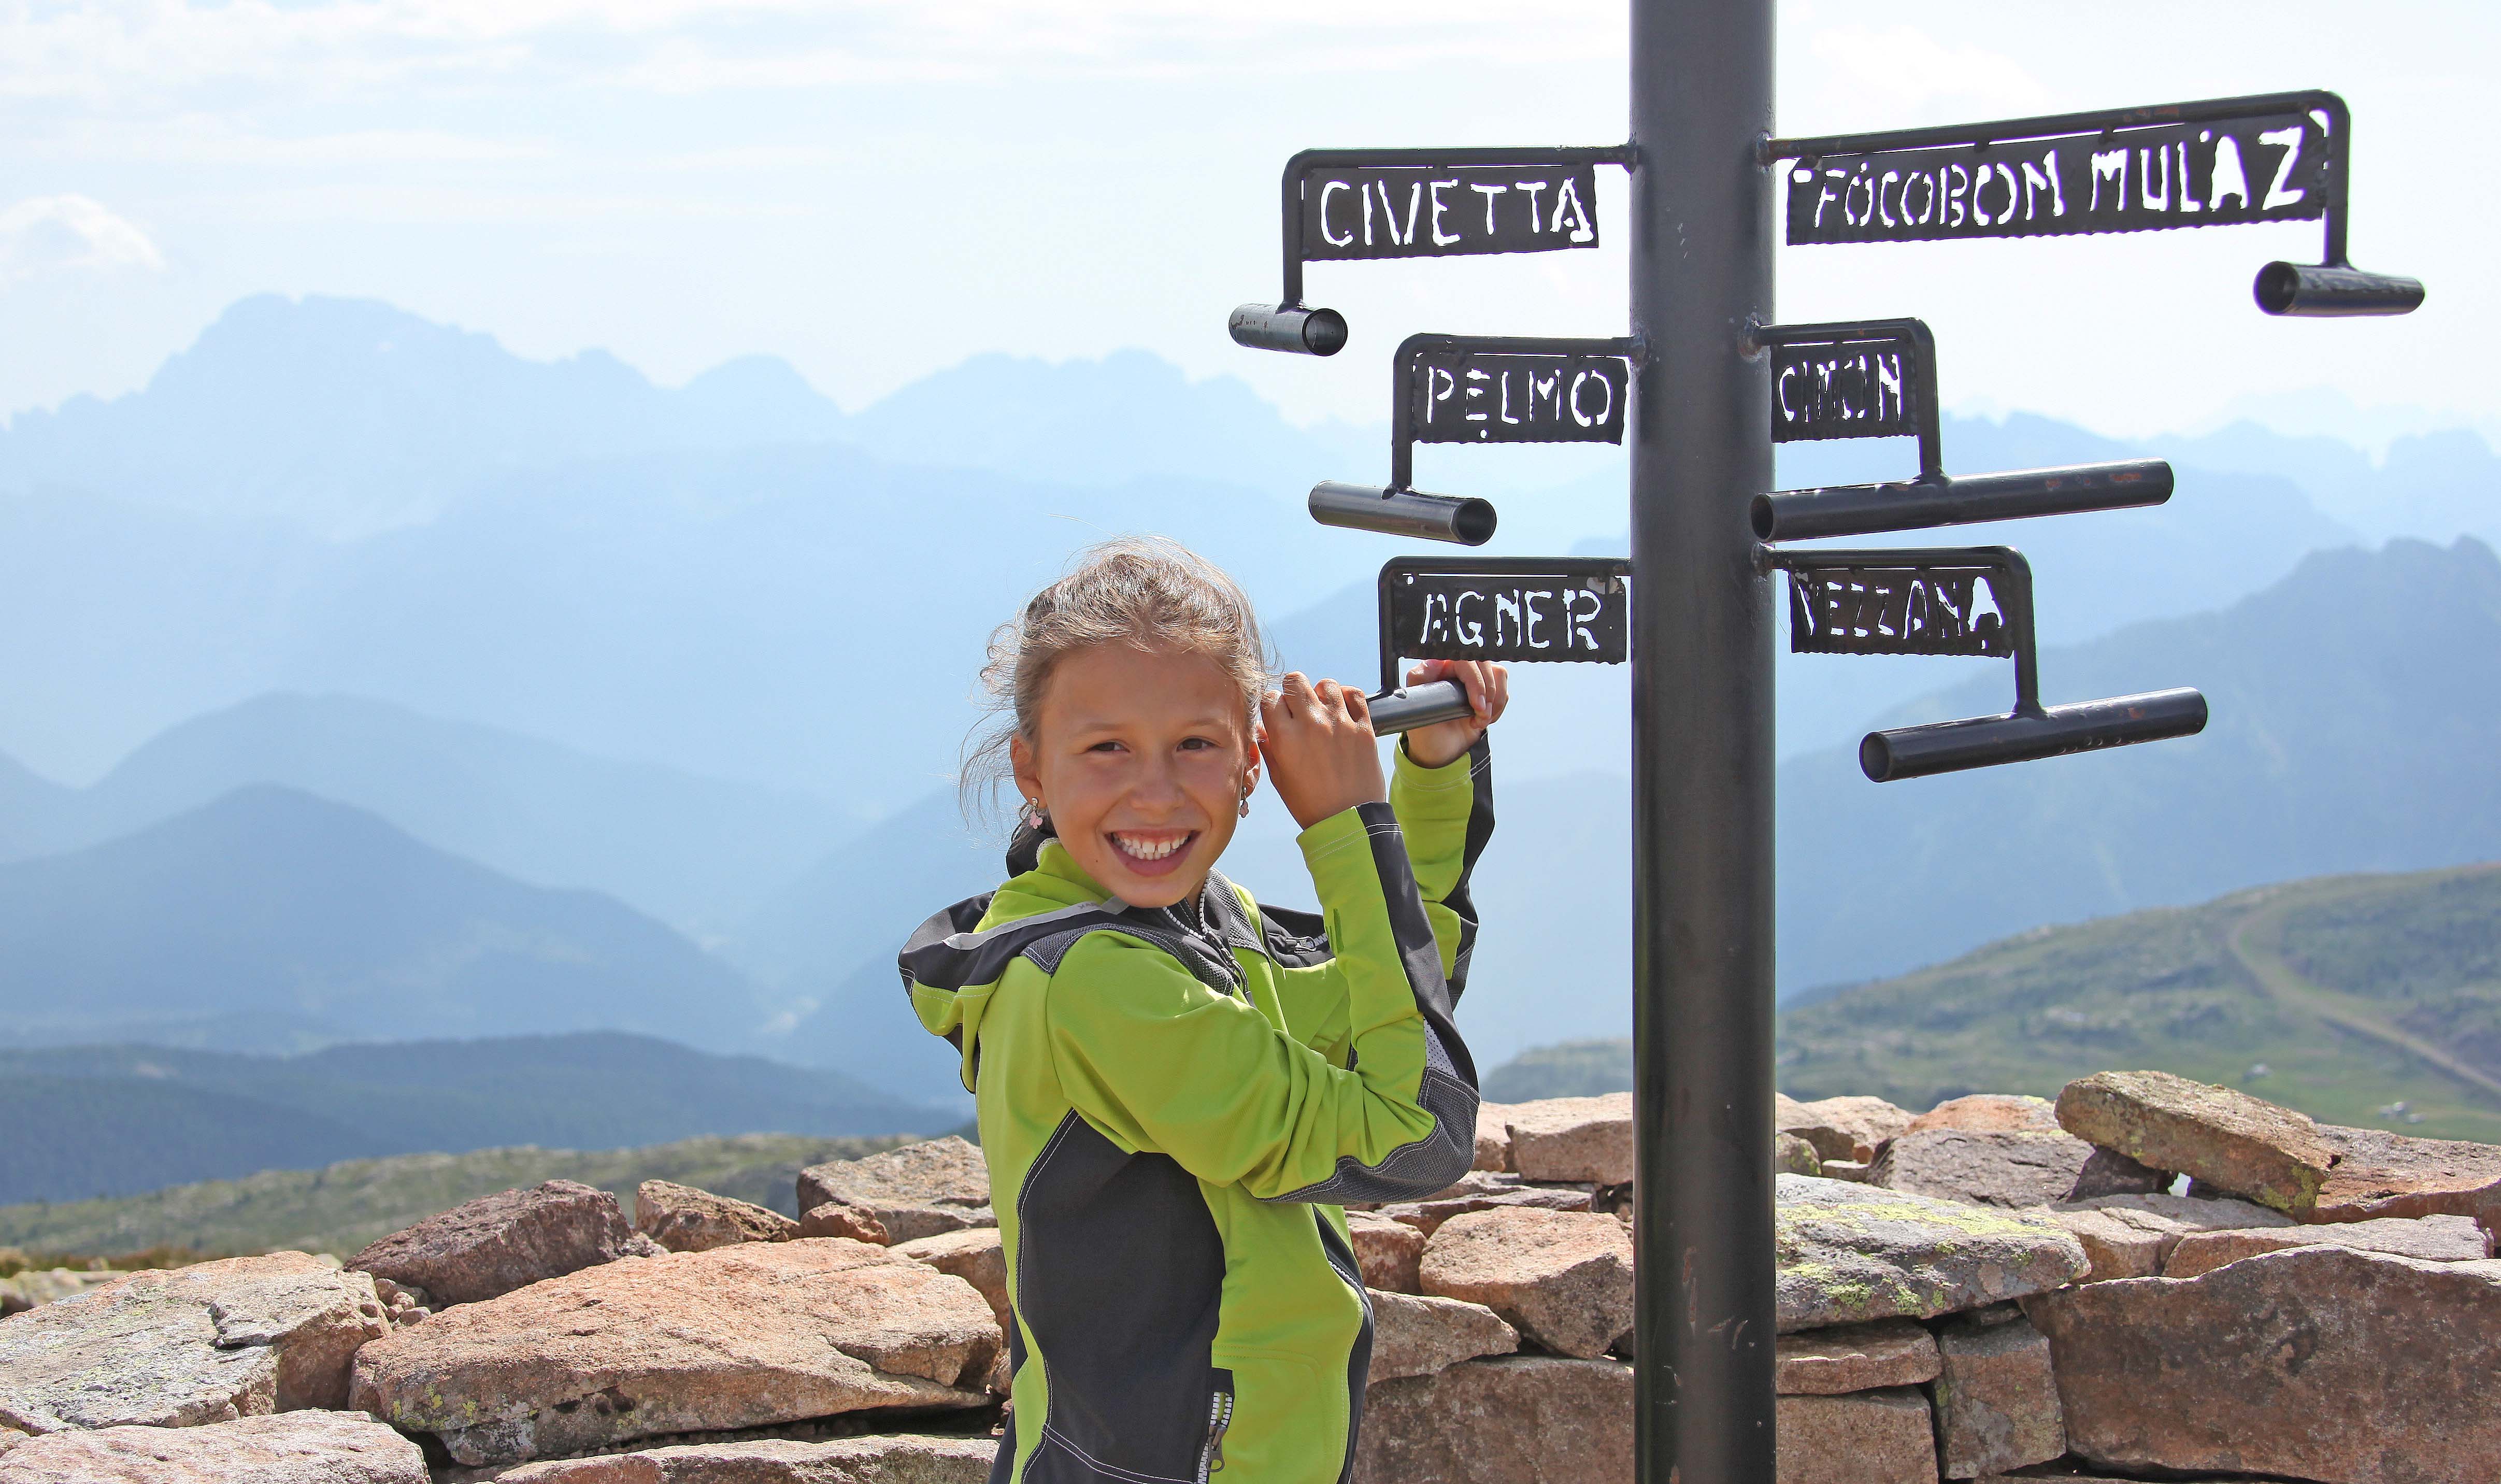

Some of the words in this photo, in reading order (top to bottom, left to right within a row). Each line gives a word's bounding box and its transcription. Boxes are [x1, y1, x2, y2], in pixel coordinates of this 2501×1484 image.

[1320, 178, 1594, 247] CIVETTA
[1426, 365, 1612, 428] PELMO
[1420, 588, 1602, 650] AGNER
